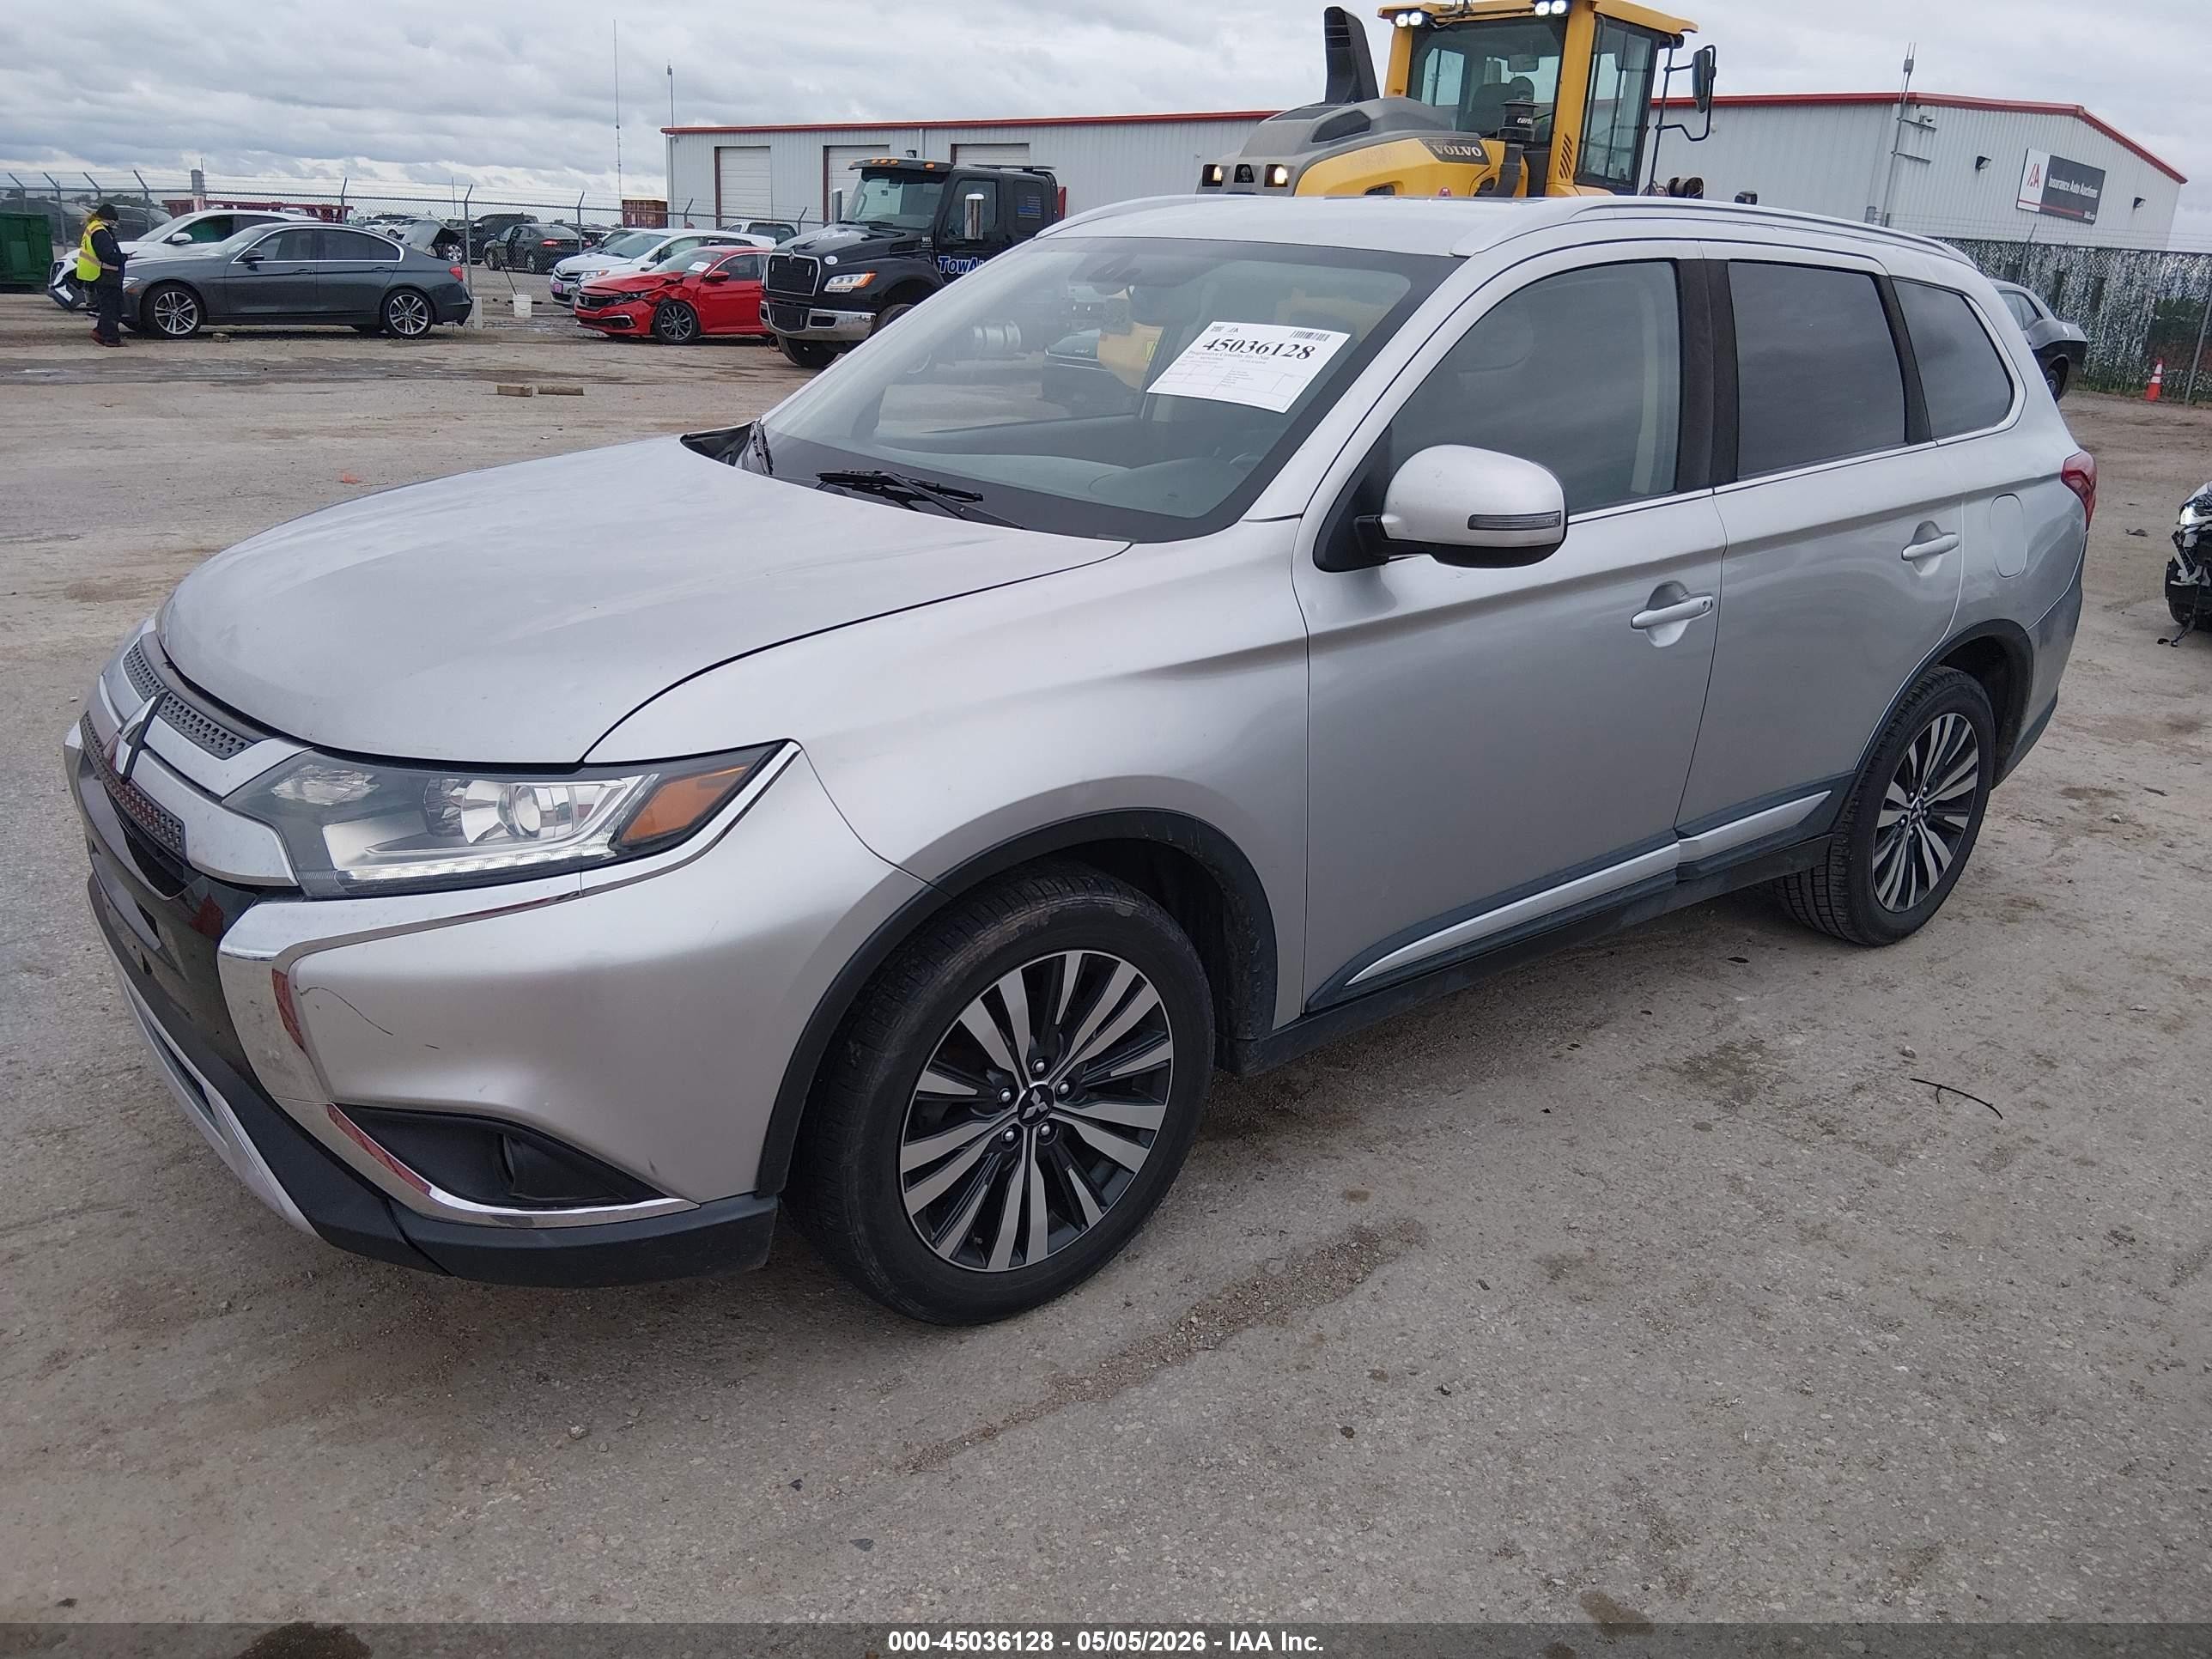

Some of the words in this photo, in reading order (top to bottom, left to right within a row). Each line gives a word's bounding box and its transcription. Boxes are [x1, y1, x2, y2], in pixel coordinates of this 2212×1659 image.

[1431, 144, 1482, 157] VOLVO
[2048, 174, 2069, 191] Insurance
[2069, 179, 2080, 194] Auto
[2080, 181, 2098, 198] Auctions
[938, 255, 985, 275] TowA
[1203, 337, 1317, 360] 45036128
